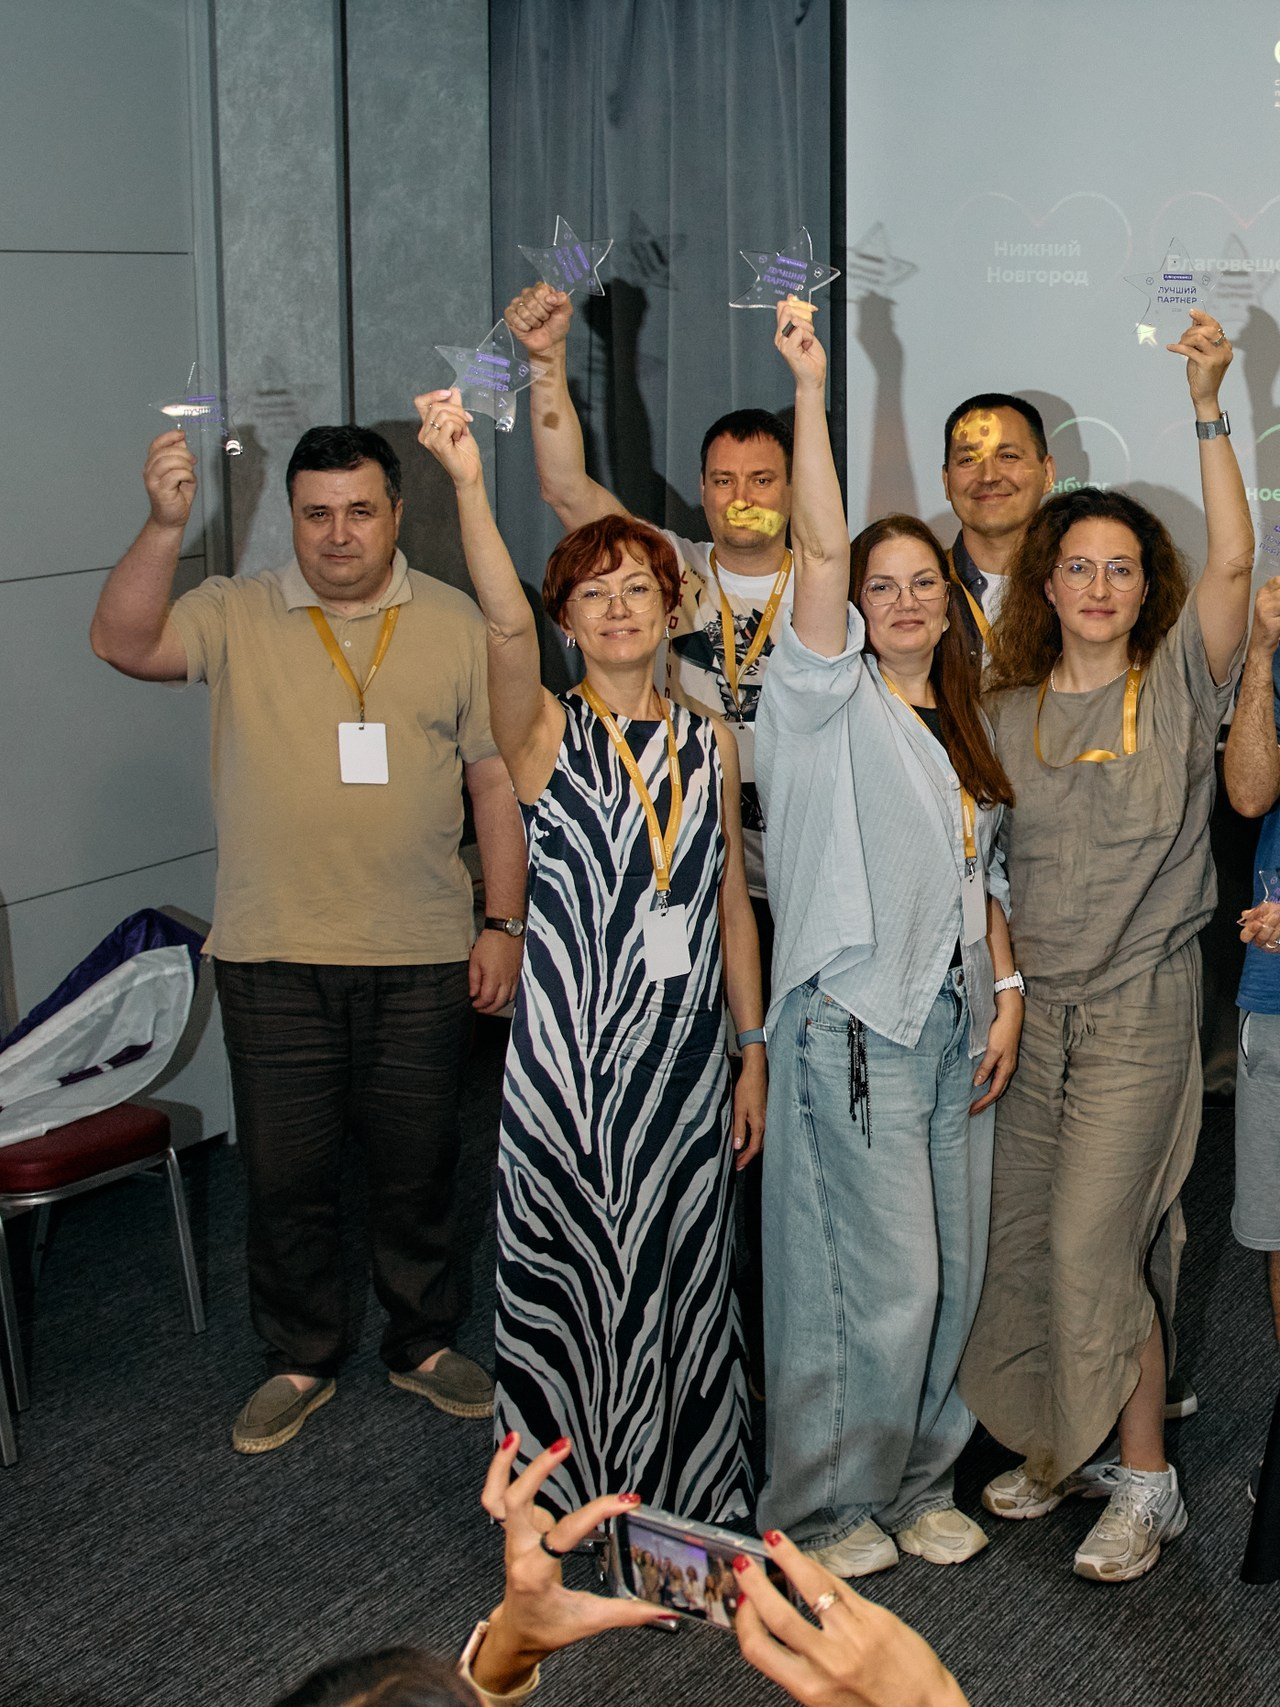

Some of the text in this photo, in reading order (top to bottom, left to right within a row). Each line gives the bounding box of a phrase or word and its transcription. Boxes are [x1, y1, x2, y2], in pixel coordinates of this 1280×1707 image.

[993, 239, 1081, 259] Нижний
[986, 265, 1089, 287] Новгород
[1157, 286, 1197, 294] ЛУЧШИЙ
[1157, 296, 1198, 304] ПАРТНЕР
